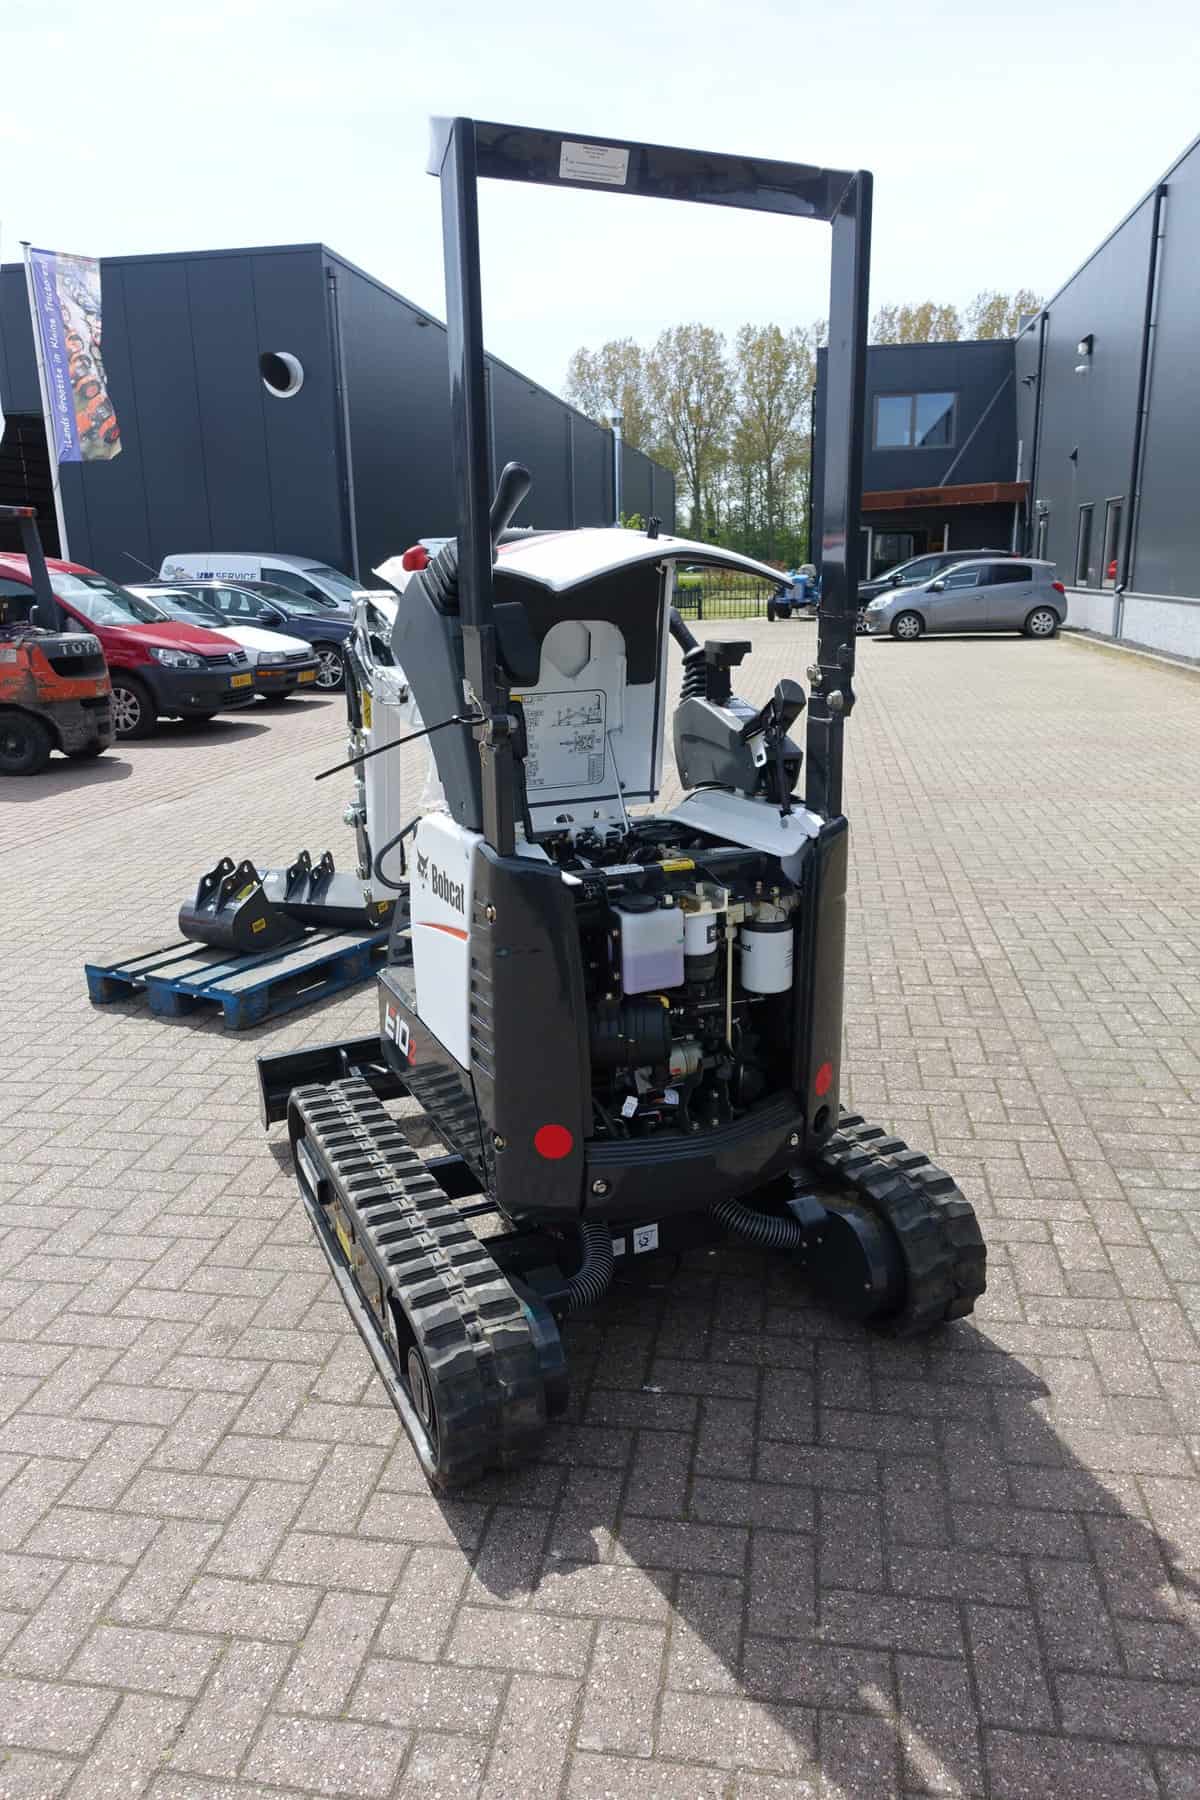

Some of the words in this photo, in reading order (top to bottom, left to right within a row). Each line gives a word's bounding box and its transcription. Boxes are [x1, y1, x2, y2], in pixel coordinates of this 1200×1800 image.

[53, 353, 62, 363] in
[215, 571, 256, 580] SERVICE
[431, 863, 464, 915] Bobcat
